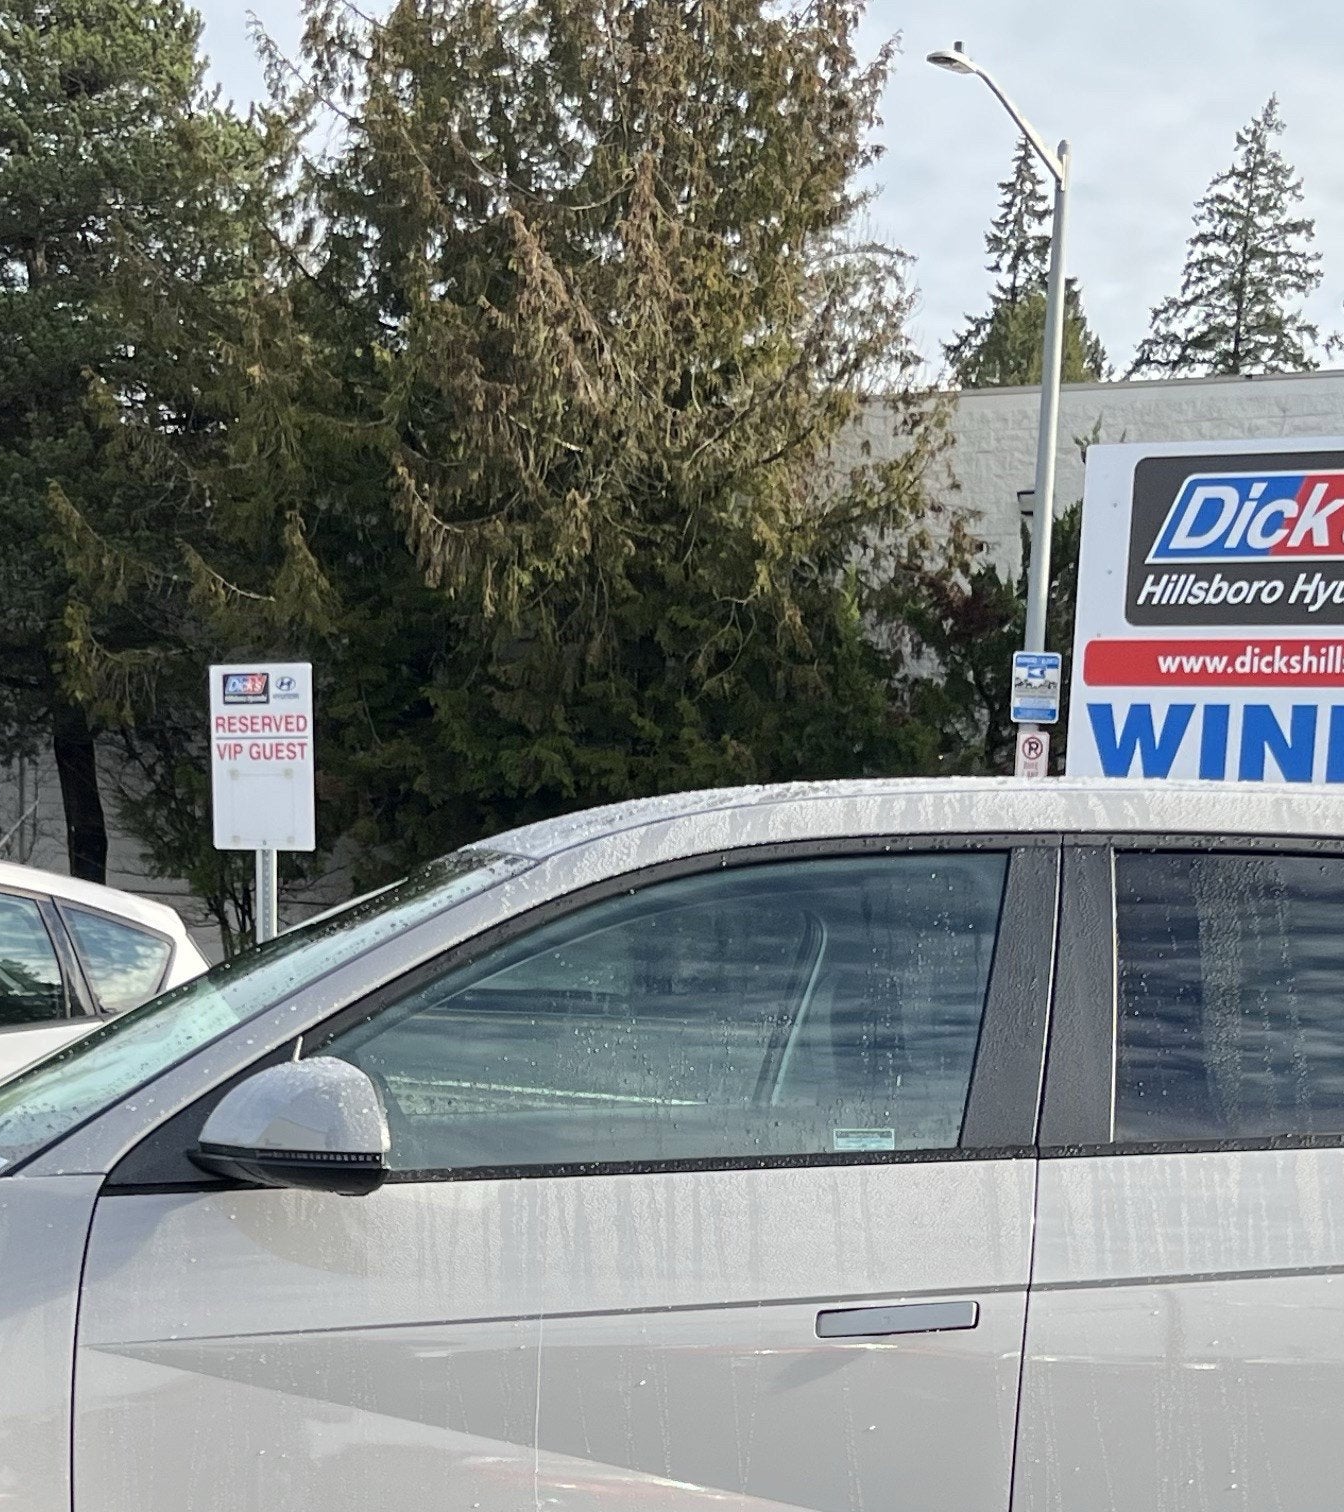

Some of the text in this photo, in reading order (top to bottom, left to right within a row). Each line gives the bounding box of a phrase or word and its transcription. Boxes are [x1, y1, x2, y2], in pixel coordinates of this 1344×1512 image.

[1136, 573, 1285, 605] Hillsboro
[215, 714, 308, 733] RESERVED
[216, 742, 308, 760] VIP GUEST
